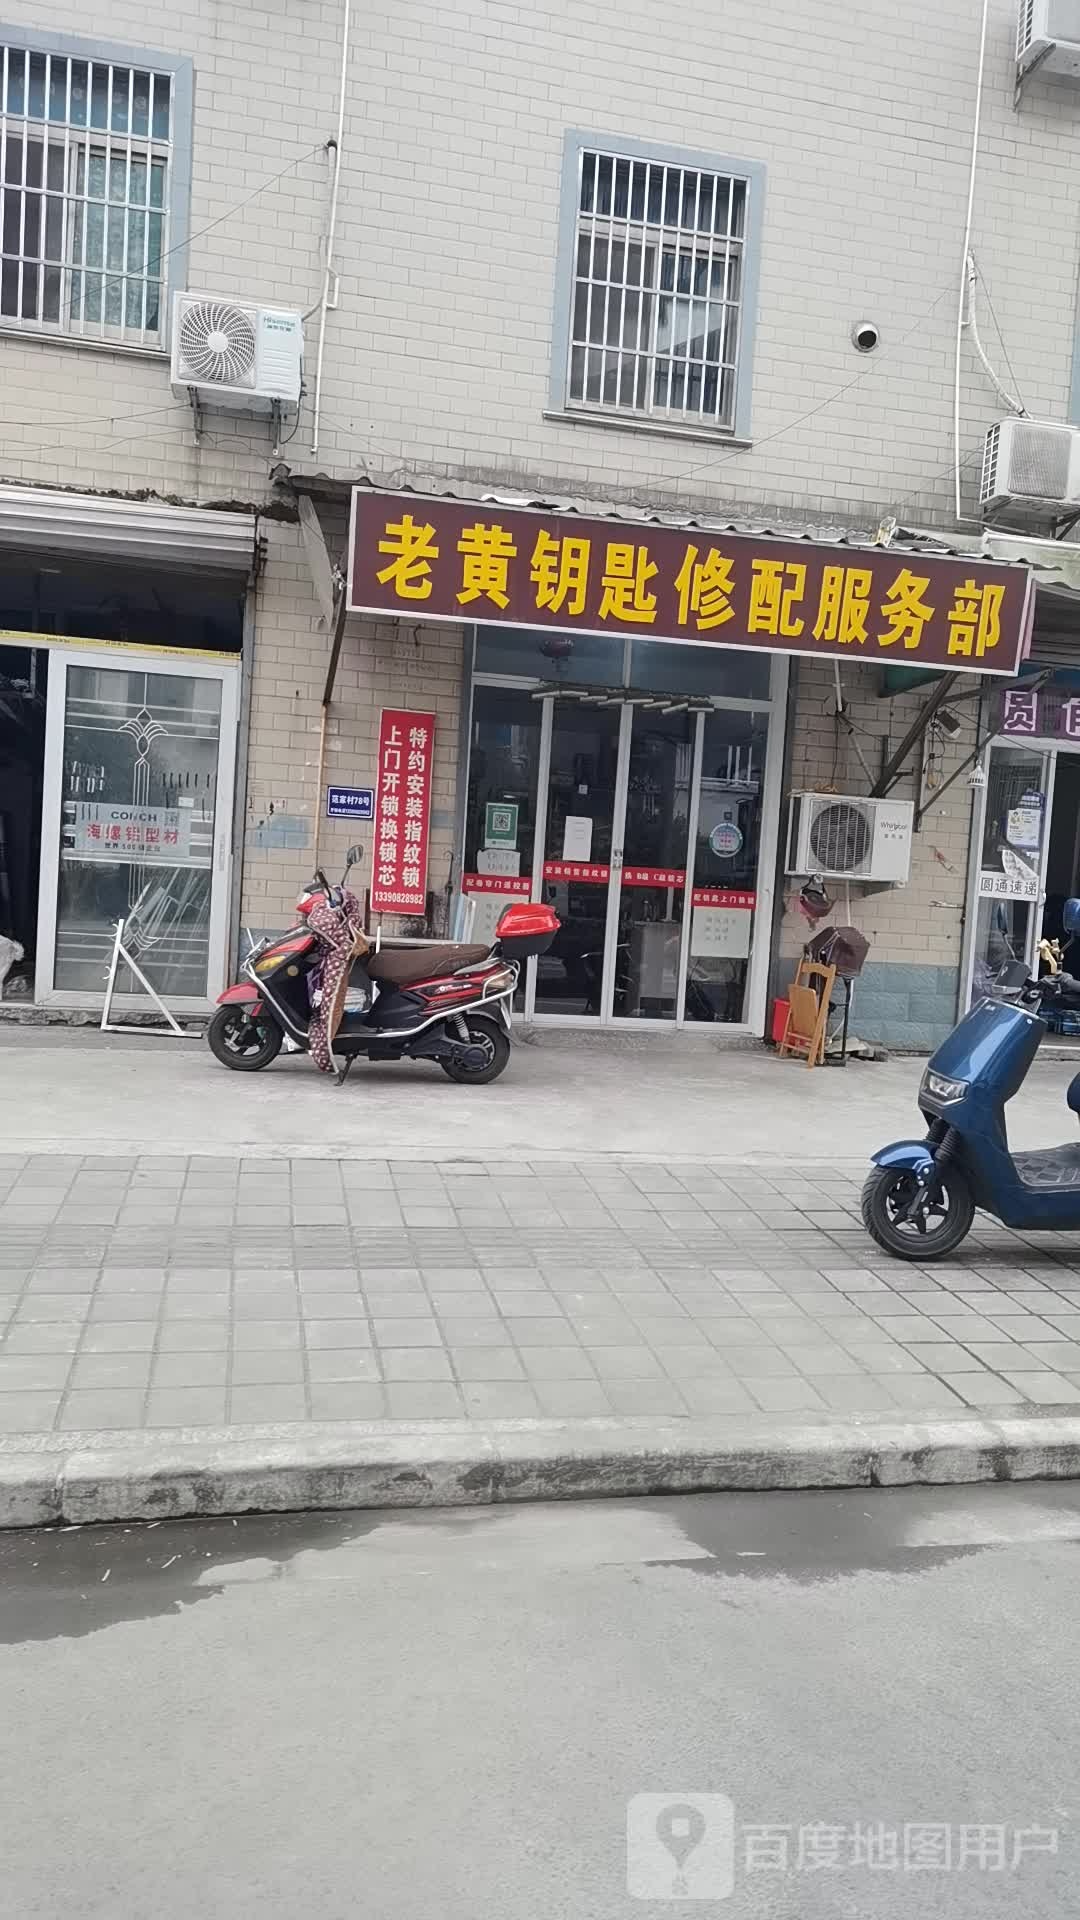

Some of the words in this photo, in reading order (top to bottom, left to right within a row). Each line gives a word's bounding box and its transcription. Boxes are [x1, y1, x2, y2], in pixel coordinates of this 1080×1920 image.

[376, 514, 1006, 657] 老黄钥匙修配服务部
[378, 725, 402, 886] 上门开锁换锁芯
[402, 727, 428, 887] 特约安装指纹锁
[374, 890, 424, 905] 13390828982
[981, 877, 1037, 896] 圆通速递
